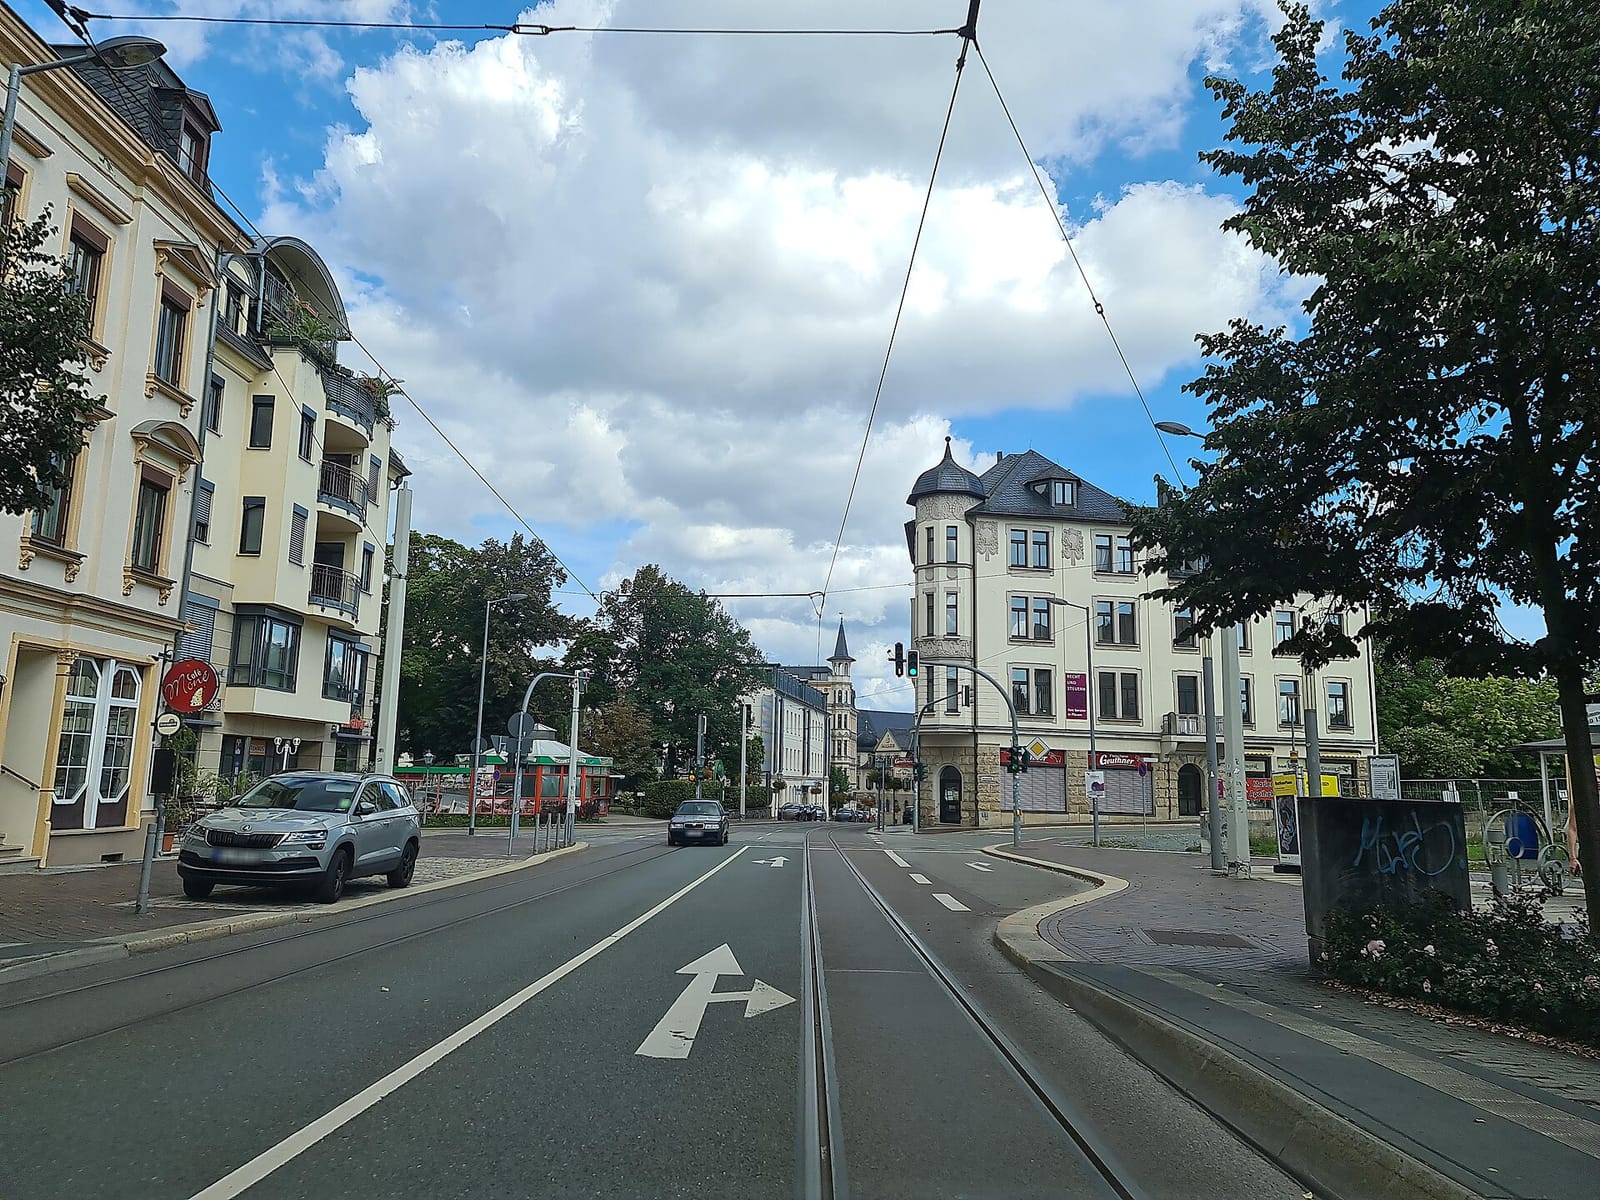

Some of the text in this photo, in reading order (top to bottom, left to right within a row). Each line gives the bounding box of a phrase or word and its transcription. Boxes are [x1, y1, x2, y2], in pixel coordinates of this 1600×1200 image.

[187, 669, 202, 680] Café
[1100, 755, 1134, 765] Geuthner
[1250, 790, 1274, 798] Apothek
